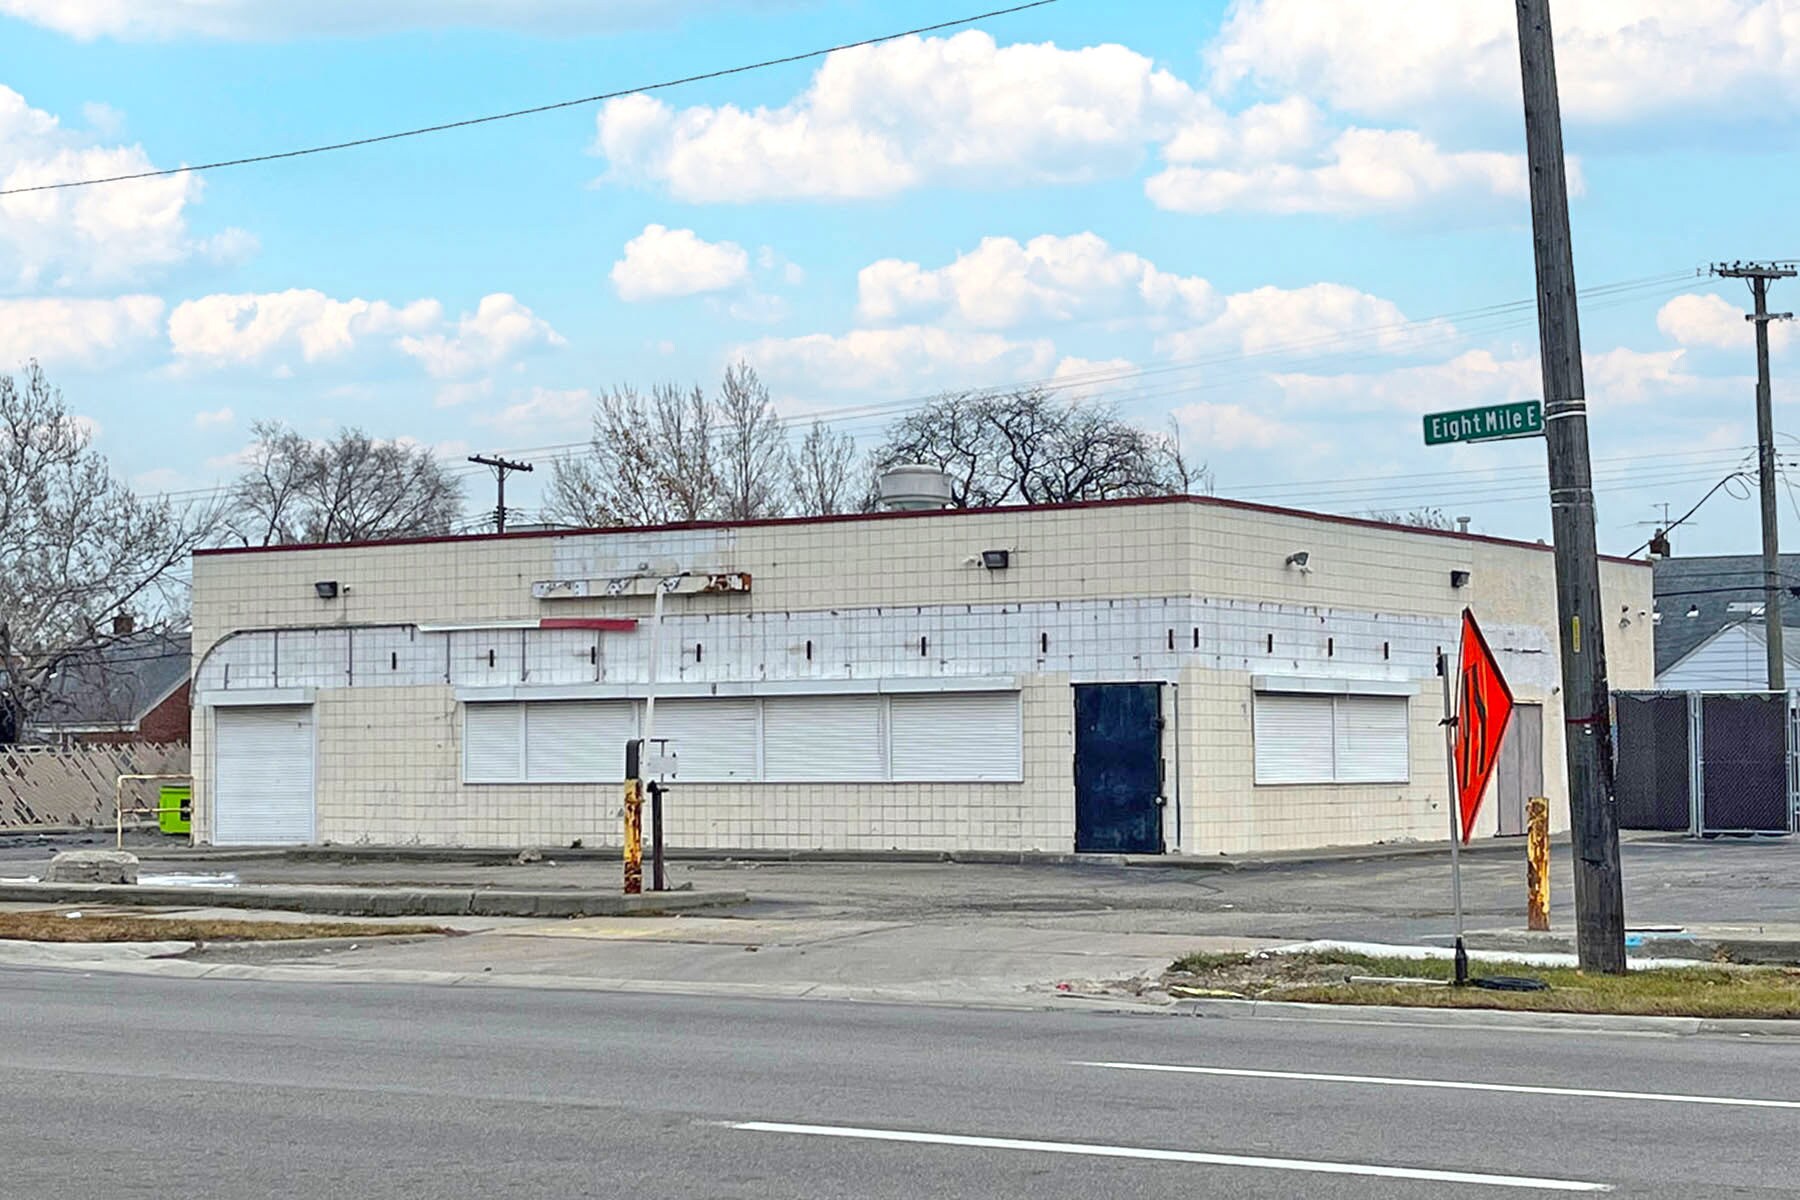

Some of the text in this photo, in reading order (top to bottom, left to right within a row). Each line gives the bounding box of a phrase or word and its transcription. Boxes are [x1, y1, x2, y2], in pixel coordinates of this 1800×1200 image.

[1432, 406, 1537, 440] Eight Mile E
